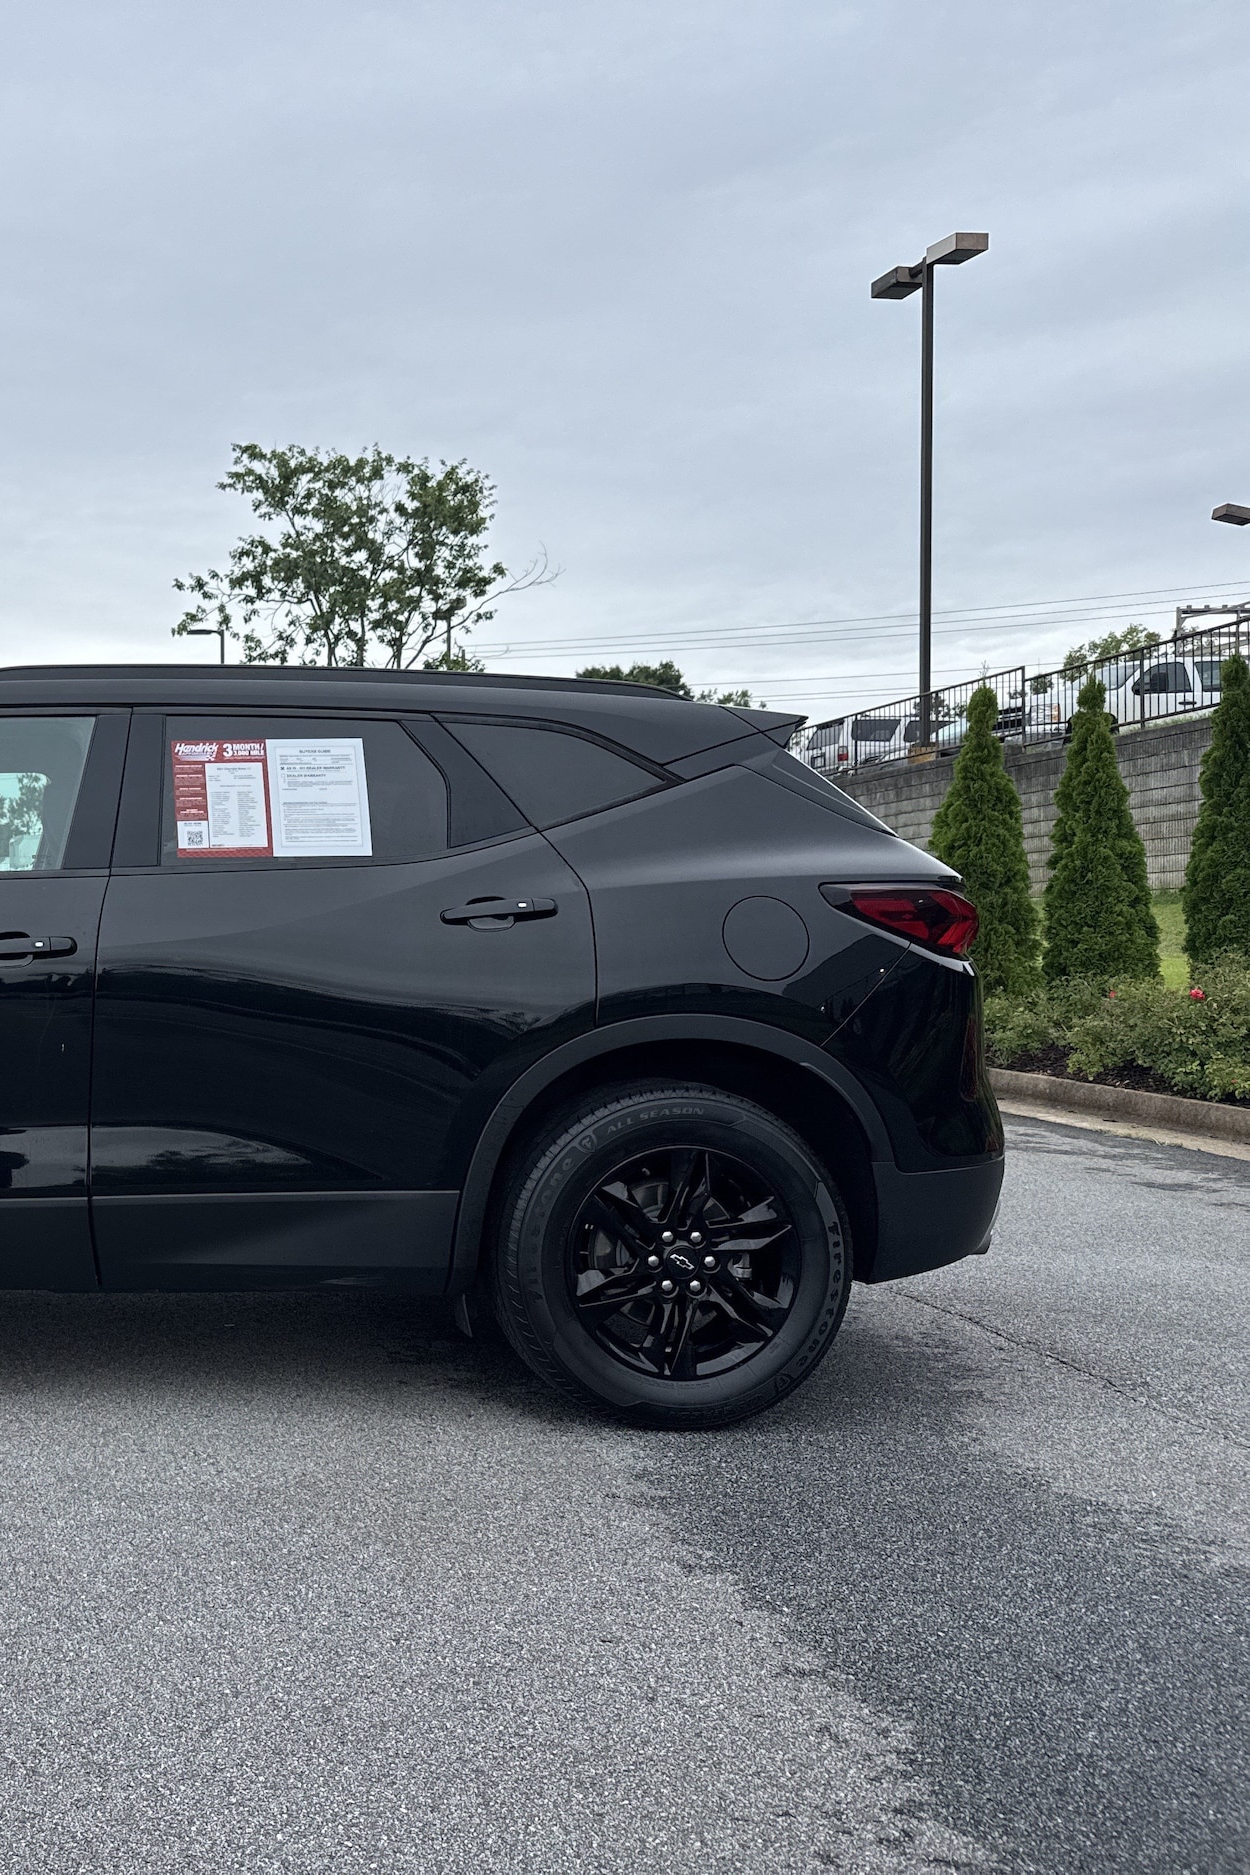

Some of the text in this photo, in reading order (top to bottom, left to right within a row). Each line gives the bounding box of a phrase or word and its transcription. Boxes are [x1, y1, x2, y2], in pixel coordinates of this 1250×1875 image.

[222, 743, 233, 757] 3
[606, 1106, 704, 1135] ALL SEASON
[797, 1221, 842, 1367] Firestone
